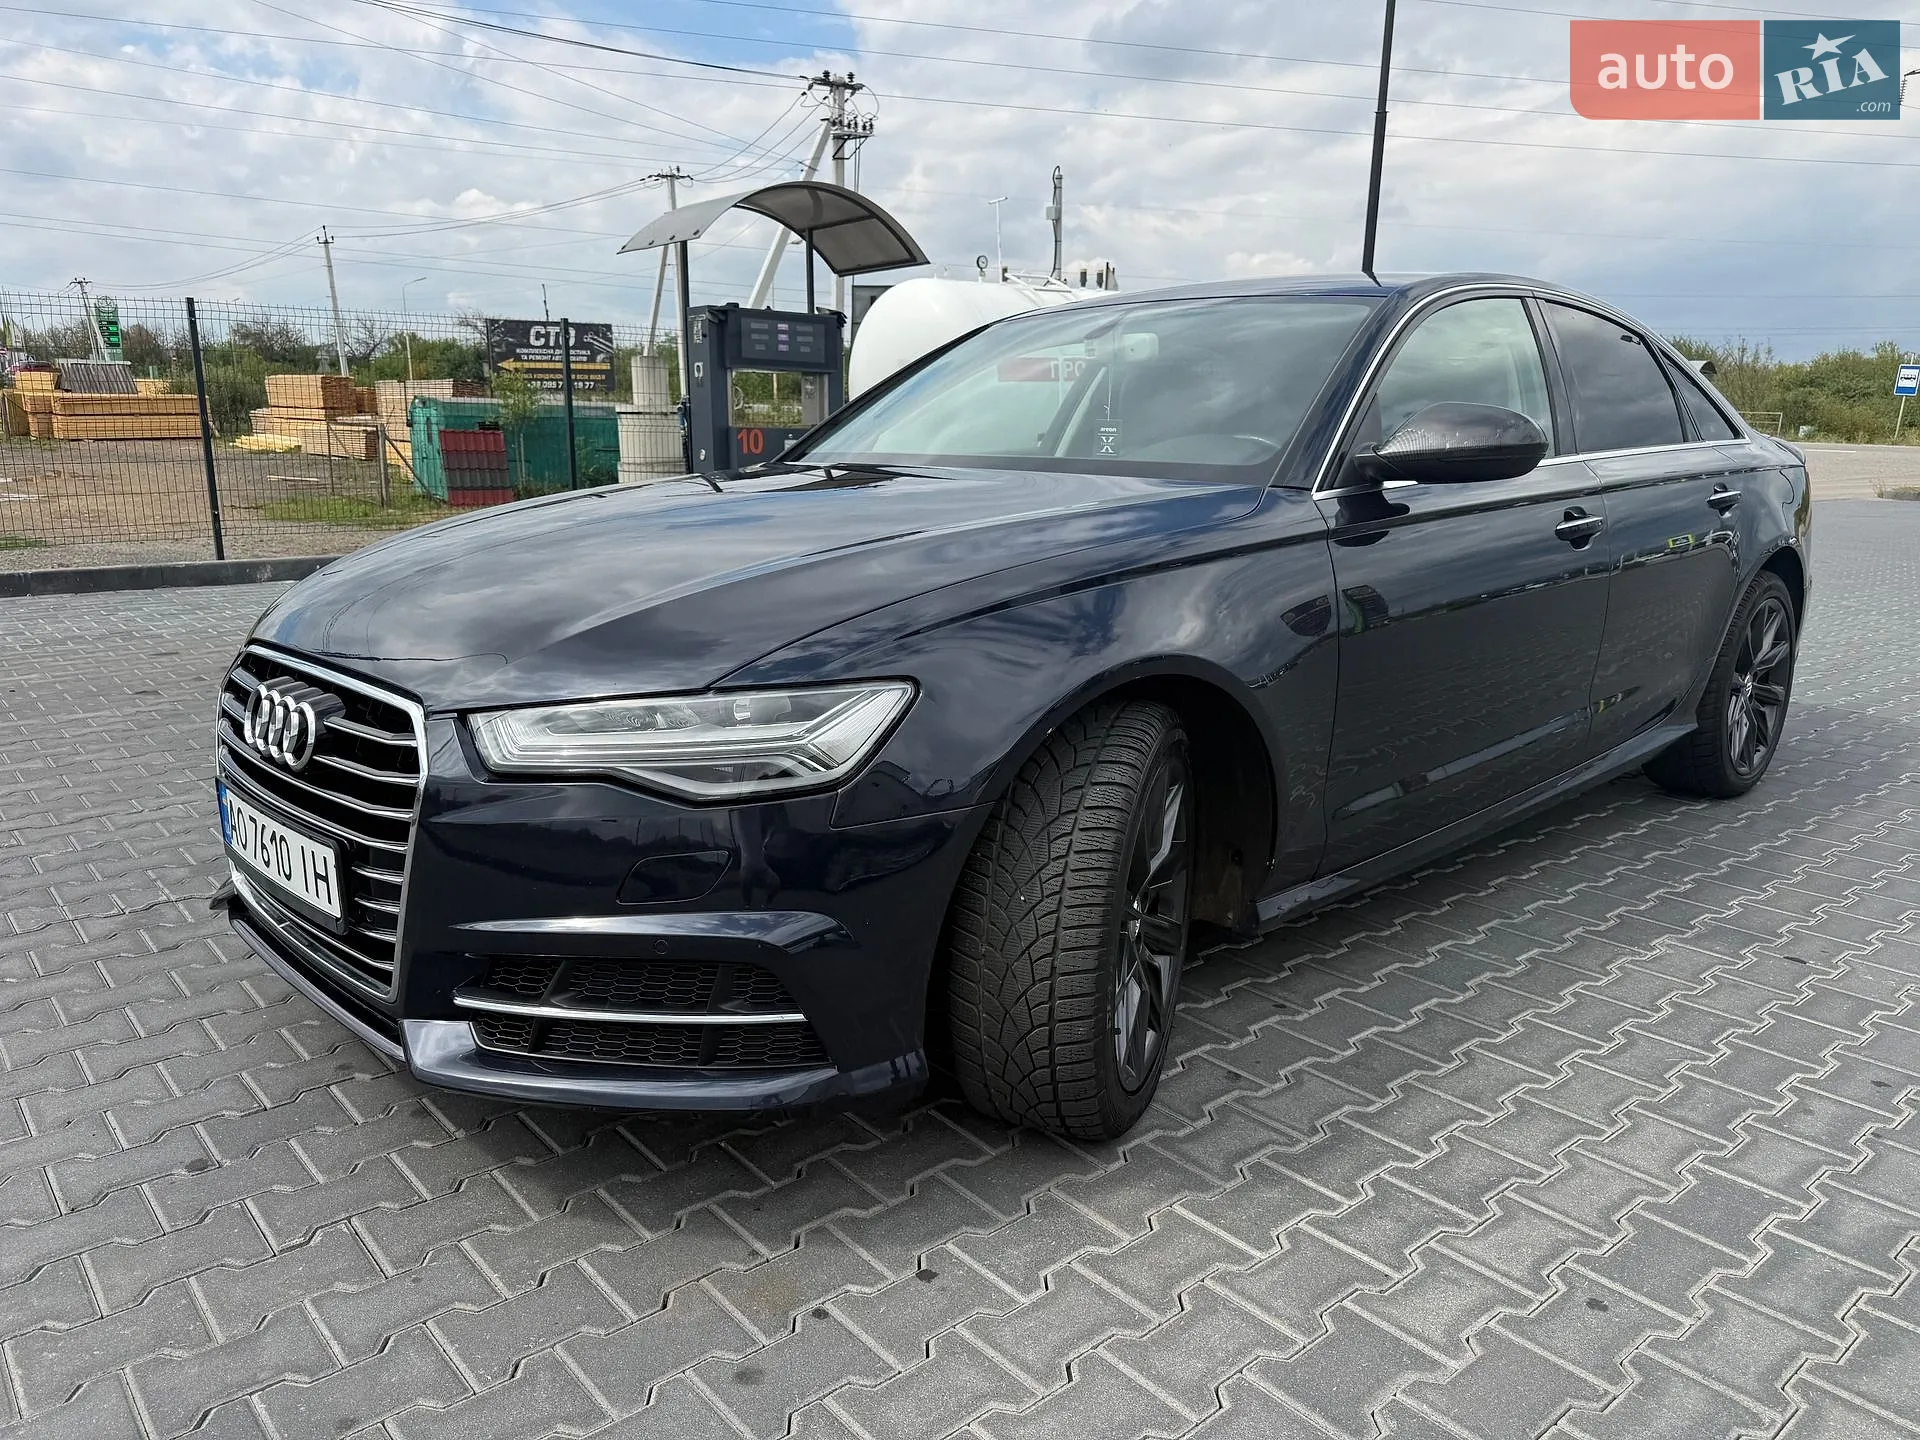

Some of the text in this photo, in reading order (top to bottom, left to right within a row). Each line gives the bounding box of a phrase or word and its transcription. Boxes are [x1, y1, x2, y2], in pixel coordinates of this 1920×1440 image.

[737, 428, 764, 455] 10
[248, 813, 292, 882] 7610
[300, 844, 333, 906] IH
